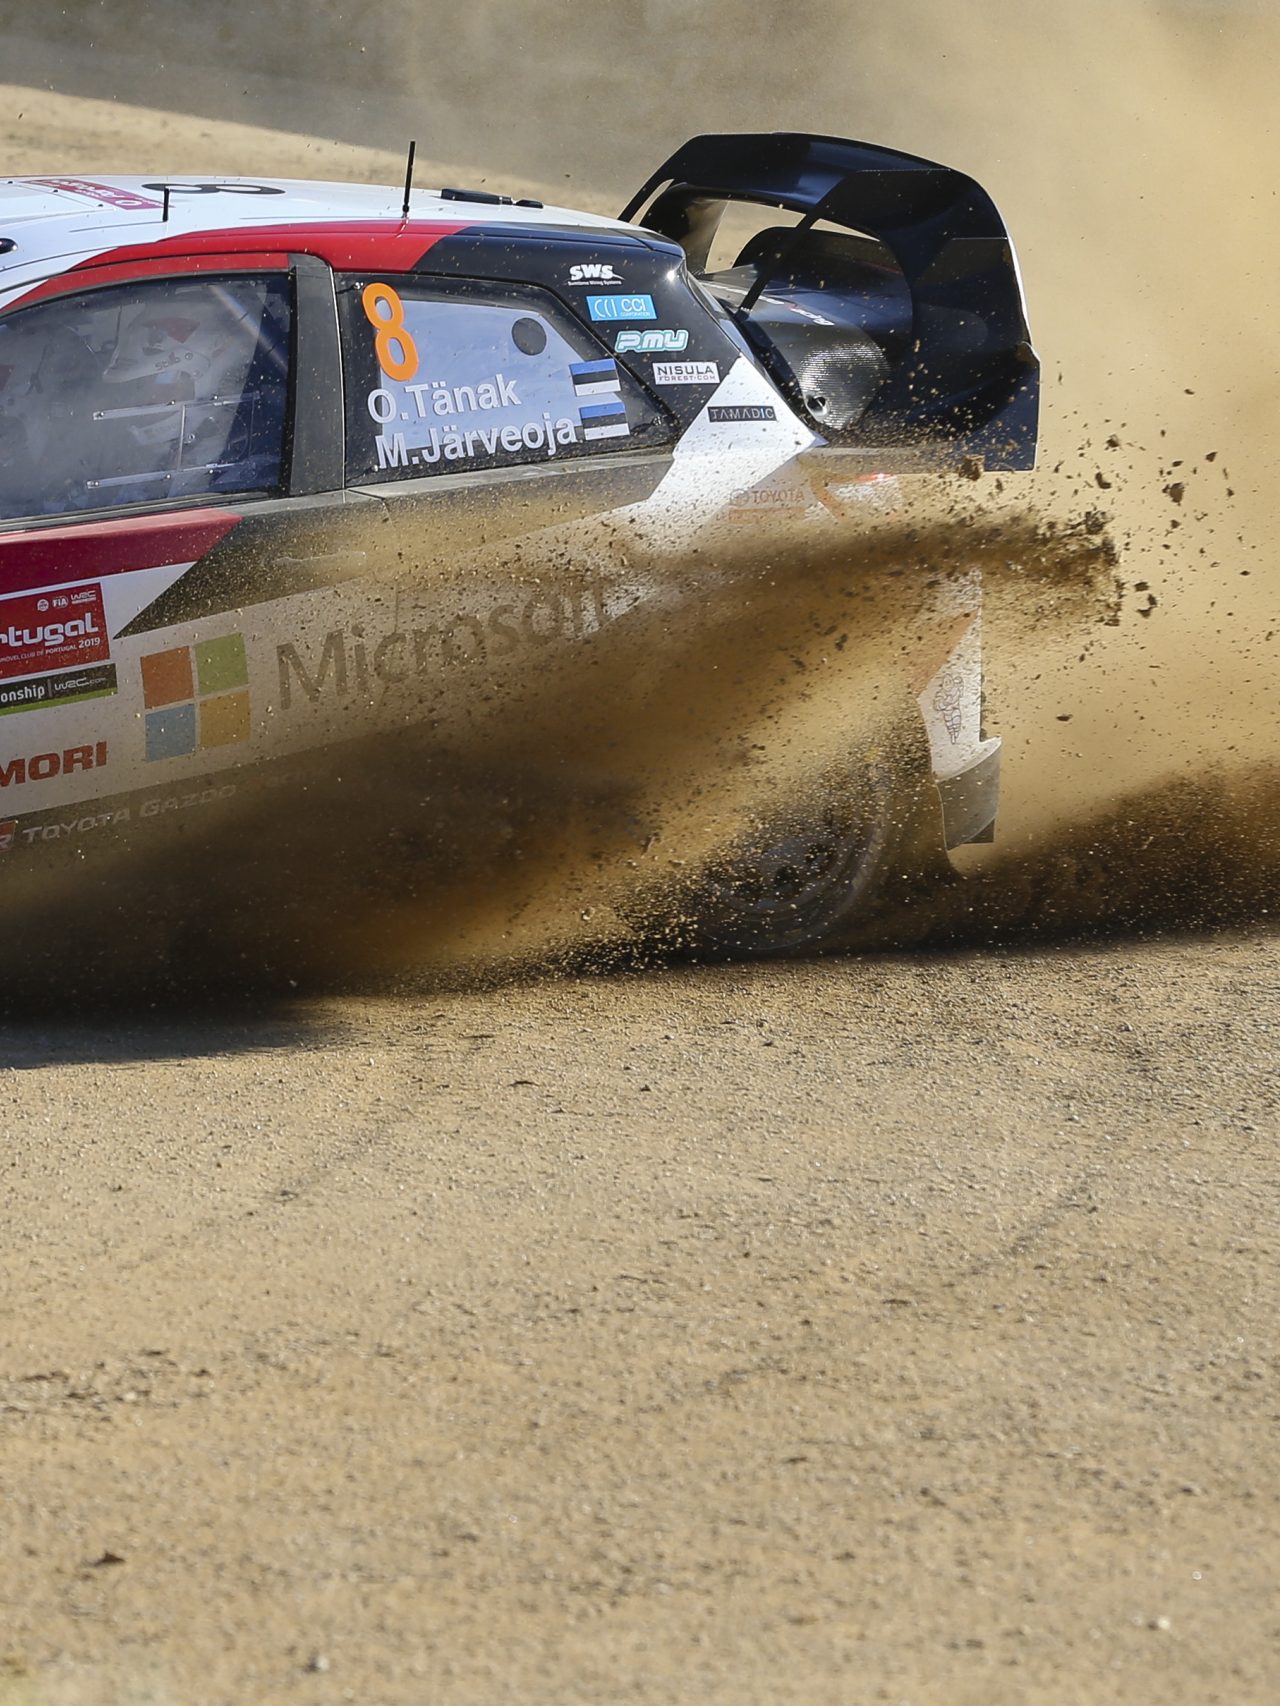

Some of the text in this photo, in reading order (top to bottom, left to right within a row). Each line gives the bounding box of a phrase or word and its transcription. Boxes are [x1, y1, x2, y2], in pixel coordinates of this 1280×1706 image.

[569, 263, 617, 281] SWS
[621, 298, 647, 312] CCI
[361, 281, 420, 382] 8
[657, 365, 714, 375] NISULA
[367, 373, 522, 425] O.Tänak
[710, 407, 774, 421] TAMADIC
[375, 413, 578, 469] M.Järveoja
[751, 488, 805, 505] TOYOTA
[78, 637, 101, 649] 2019
[22, 807, 132, 844] TOYOTA
[138, 784, 237, 819] GAZOO
